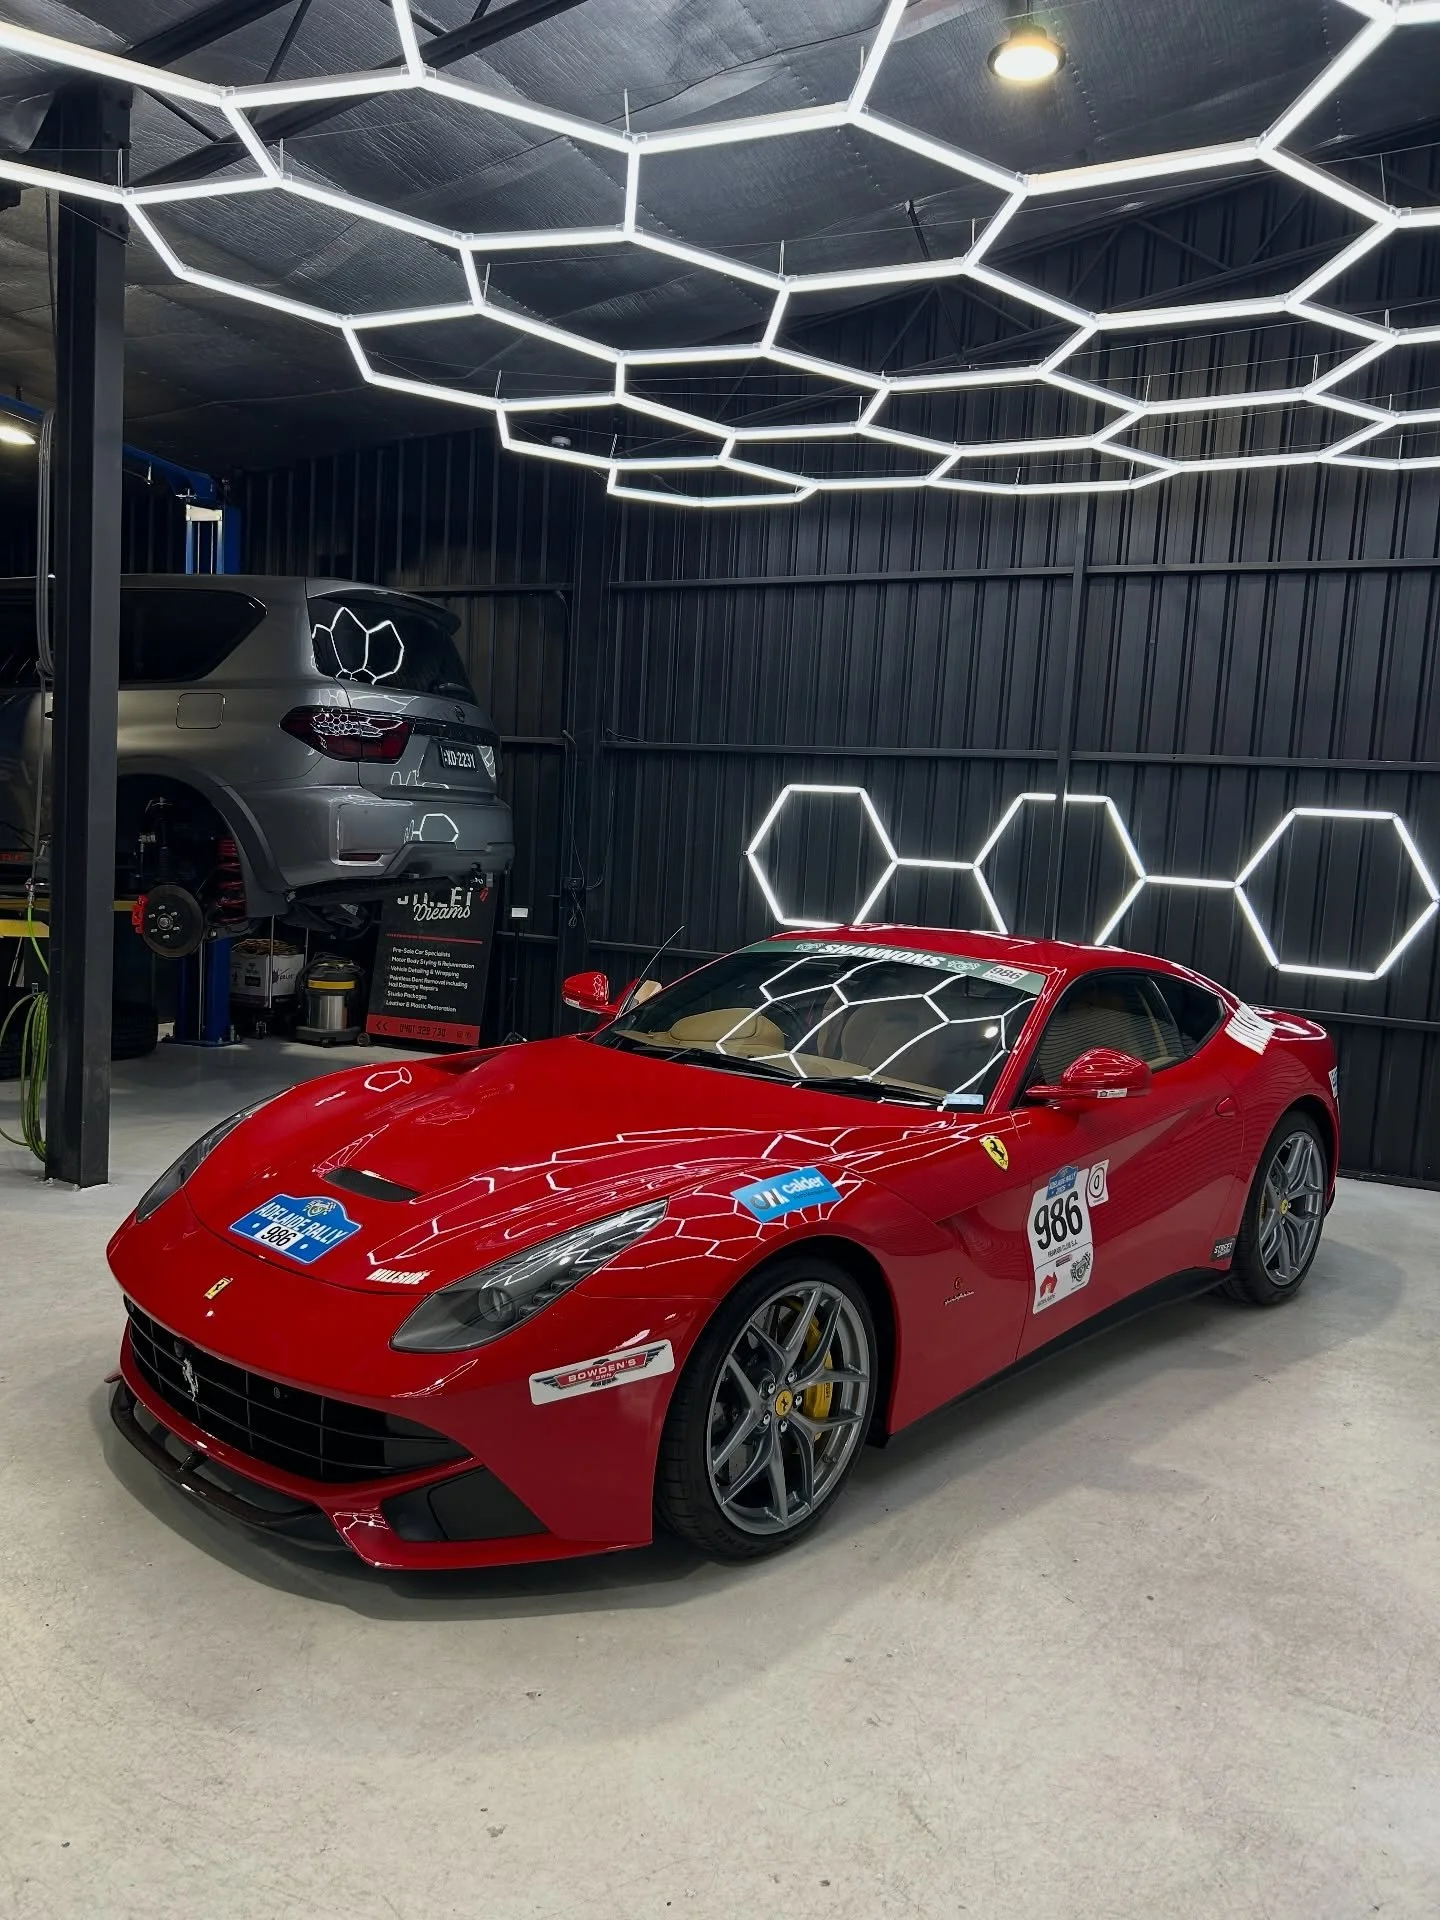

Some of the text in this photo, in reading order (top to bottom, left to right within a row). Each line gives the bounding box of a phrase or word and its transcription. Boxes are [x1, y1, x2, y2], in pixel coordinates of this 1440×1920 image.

[413, 903, 471, 921] Dreams
[392, 947, 414, 955] Pre-Sale
[425, 950, 451, 958] Specialists
[819, 944, 945, 967] SHANNONS
[435, 970, 460, 978] Wrapping
[990, 967, 1024, 980] 986
[399, 983, 418, 991] Damage
[424, 978, 445, 986] Removal
[404, 992, 427, 1000] Packages
[427, 1004, 456, 1012] Restoration
[255, 1202, 348, 1244] ADELAIDE RALLY
[1034, 1191, 1083, 1250] 986
[261, 1226, 296, 1246] 986
[568, 1358, 637, 1382] BOWDEN'S
